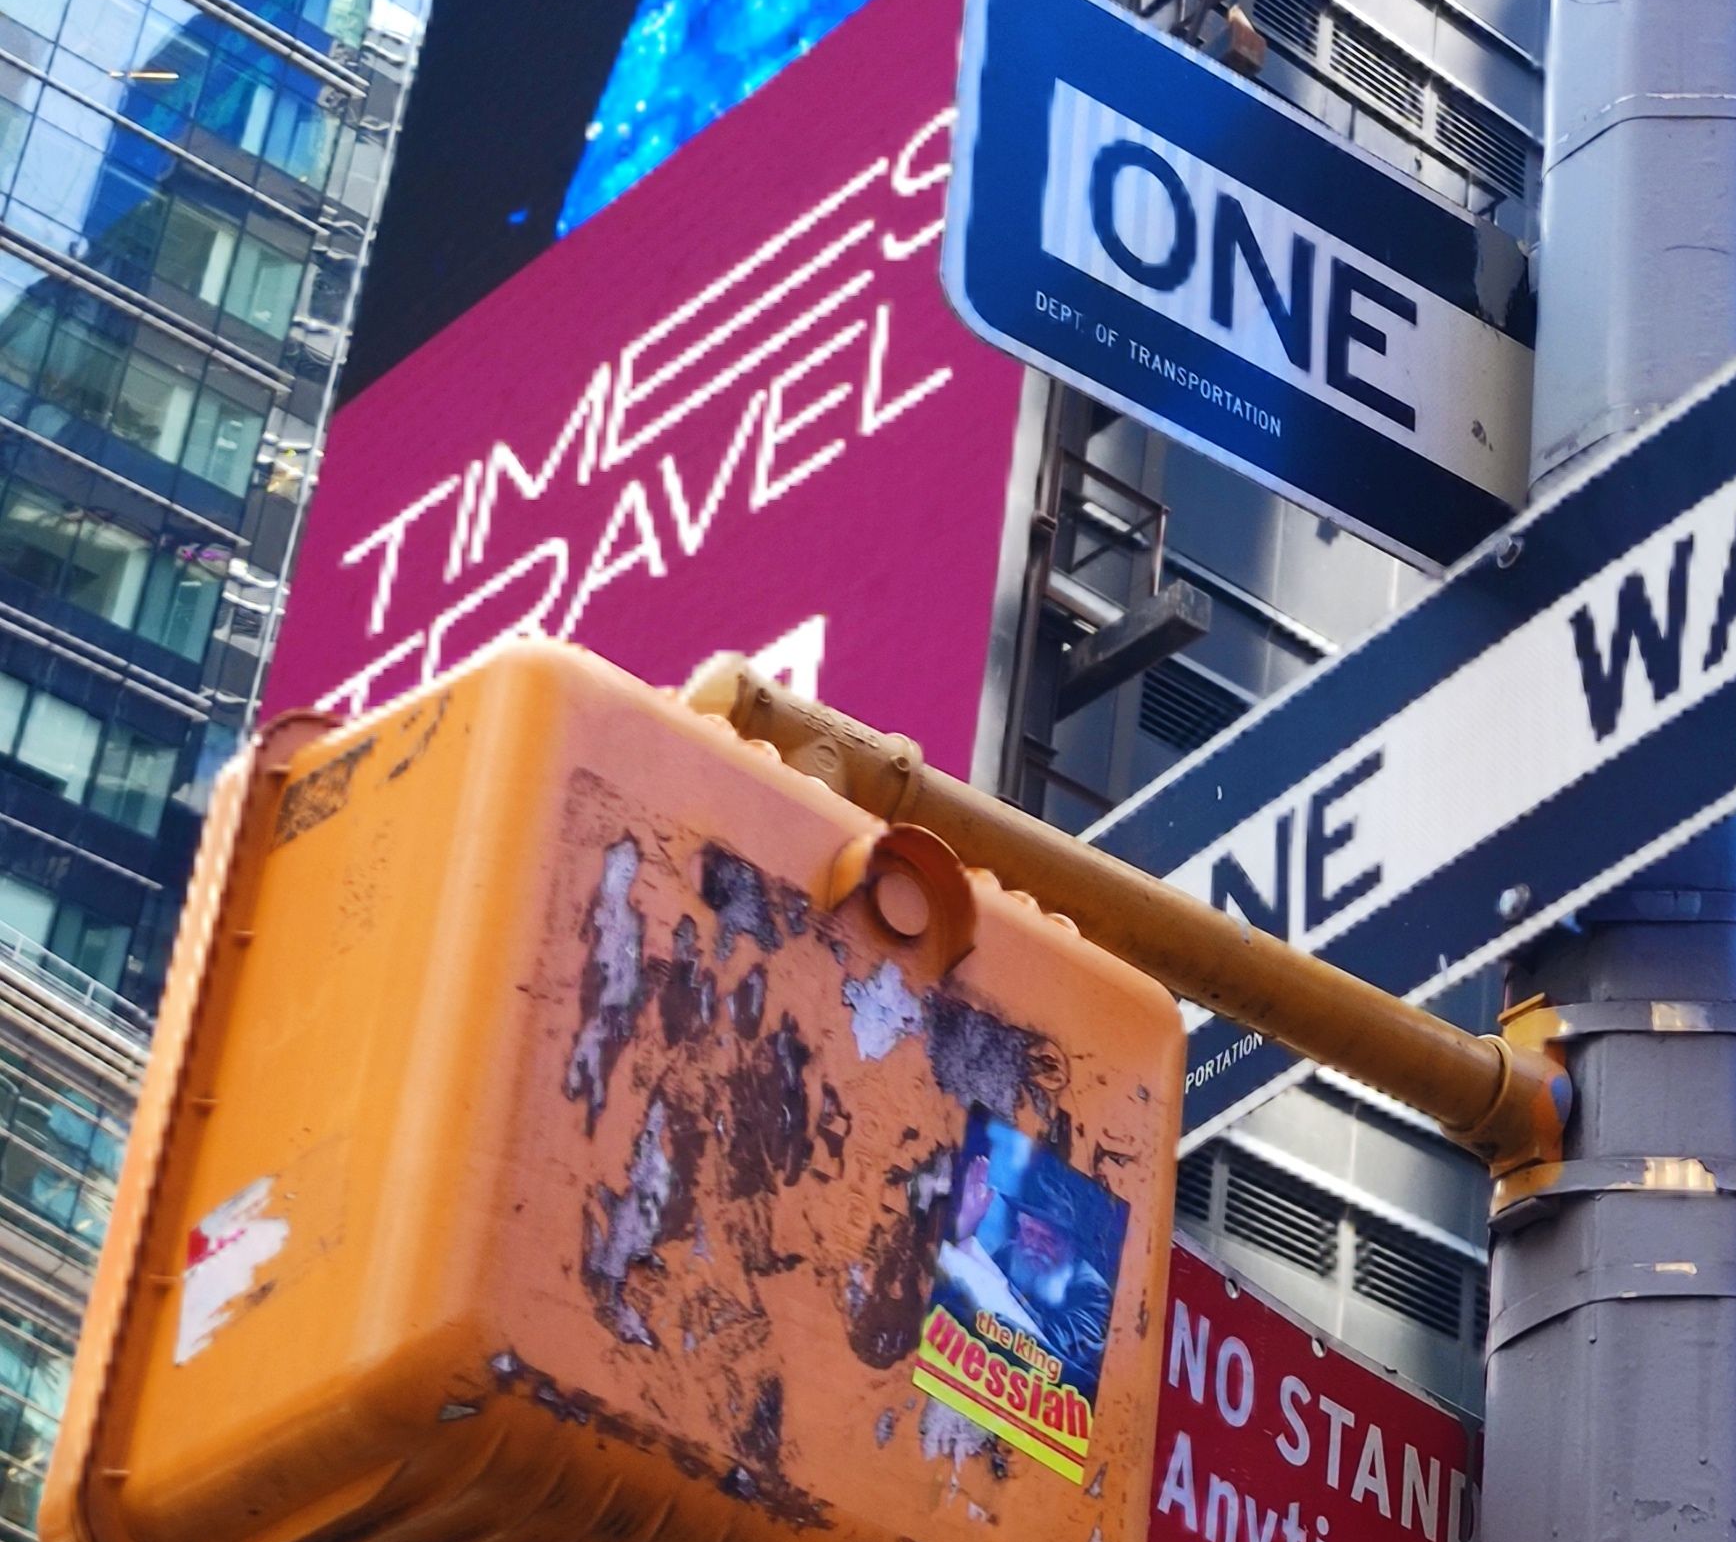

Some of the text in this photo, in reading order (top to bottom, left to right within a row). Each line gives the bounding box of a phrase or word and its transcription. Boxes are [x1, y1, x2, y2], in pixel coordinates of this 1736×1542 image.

[1088, 139, 1418, 433] ONE
[1095, 323, 1120, 348] OF
[1129, 339, 1283, 438] TRANSPORTATION
[1210, 745, 1385, 943] NE
[924, 1312, 1091, 1440] messiah
[976, 1309, 1063, 1384] the king
[1168, 1299, 1255, 1428] NO
